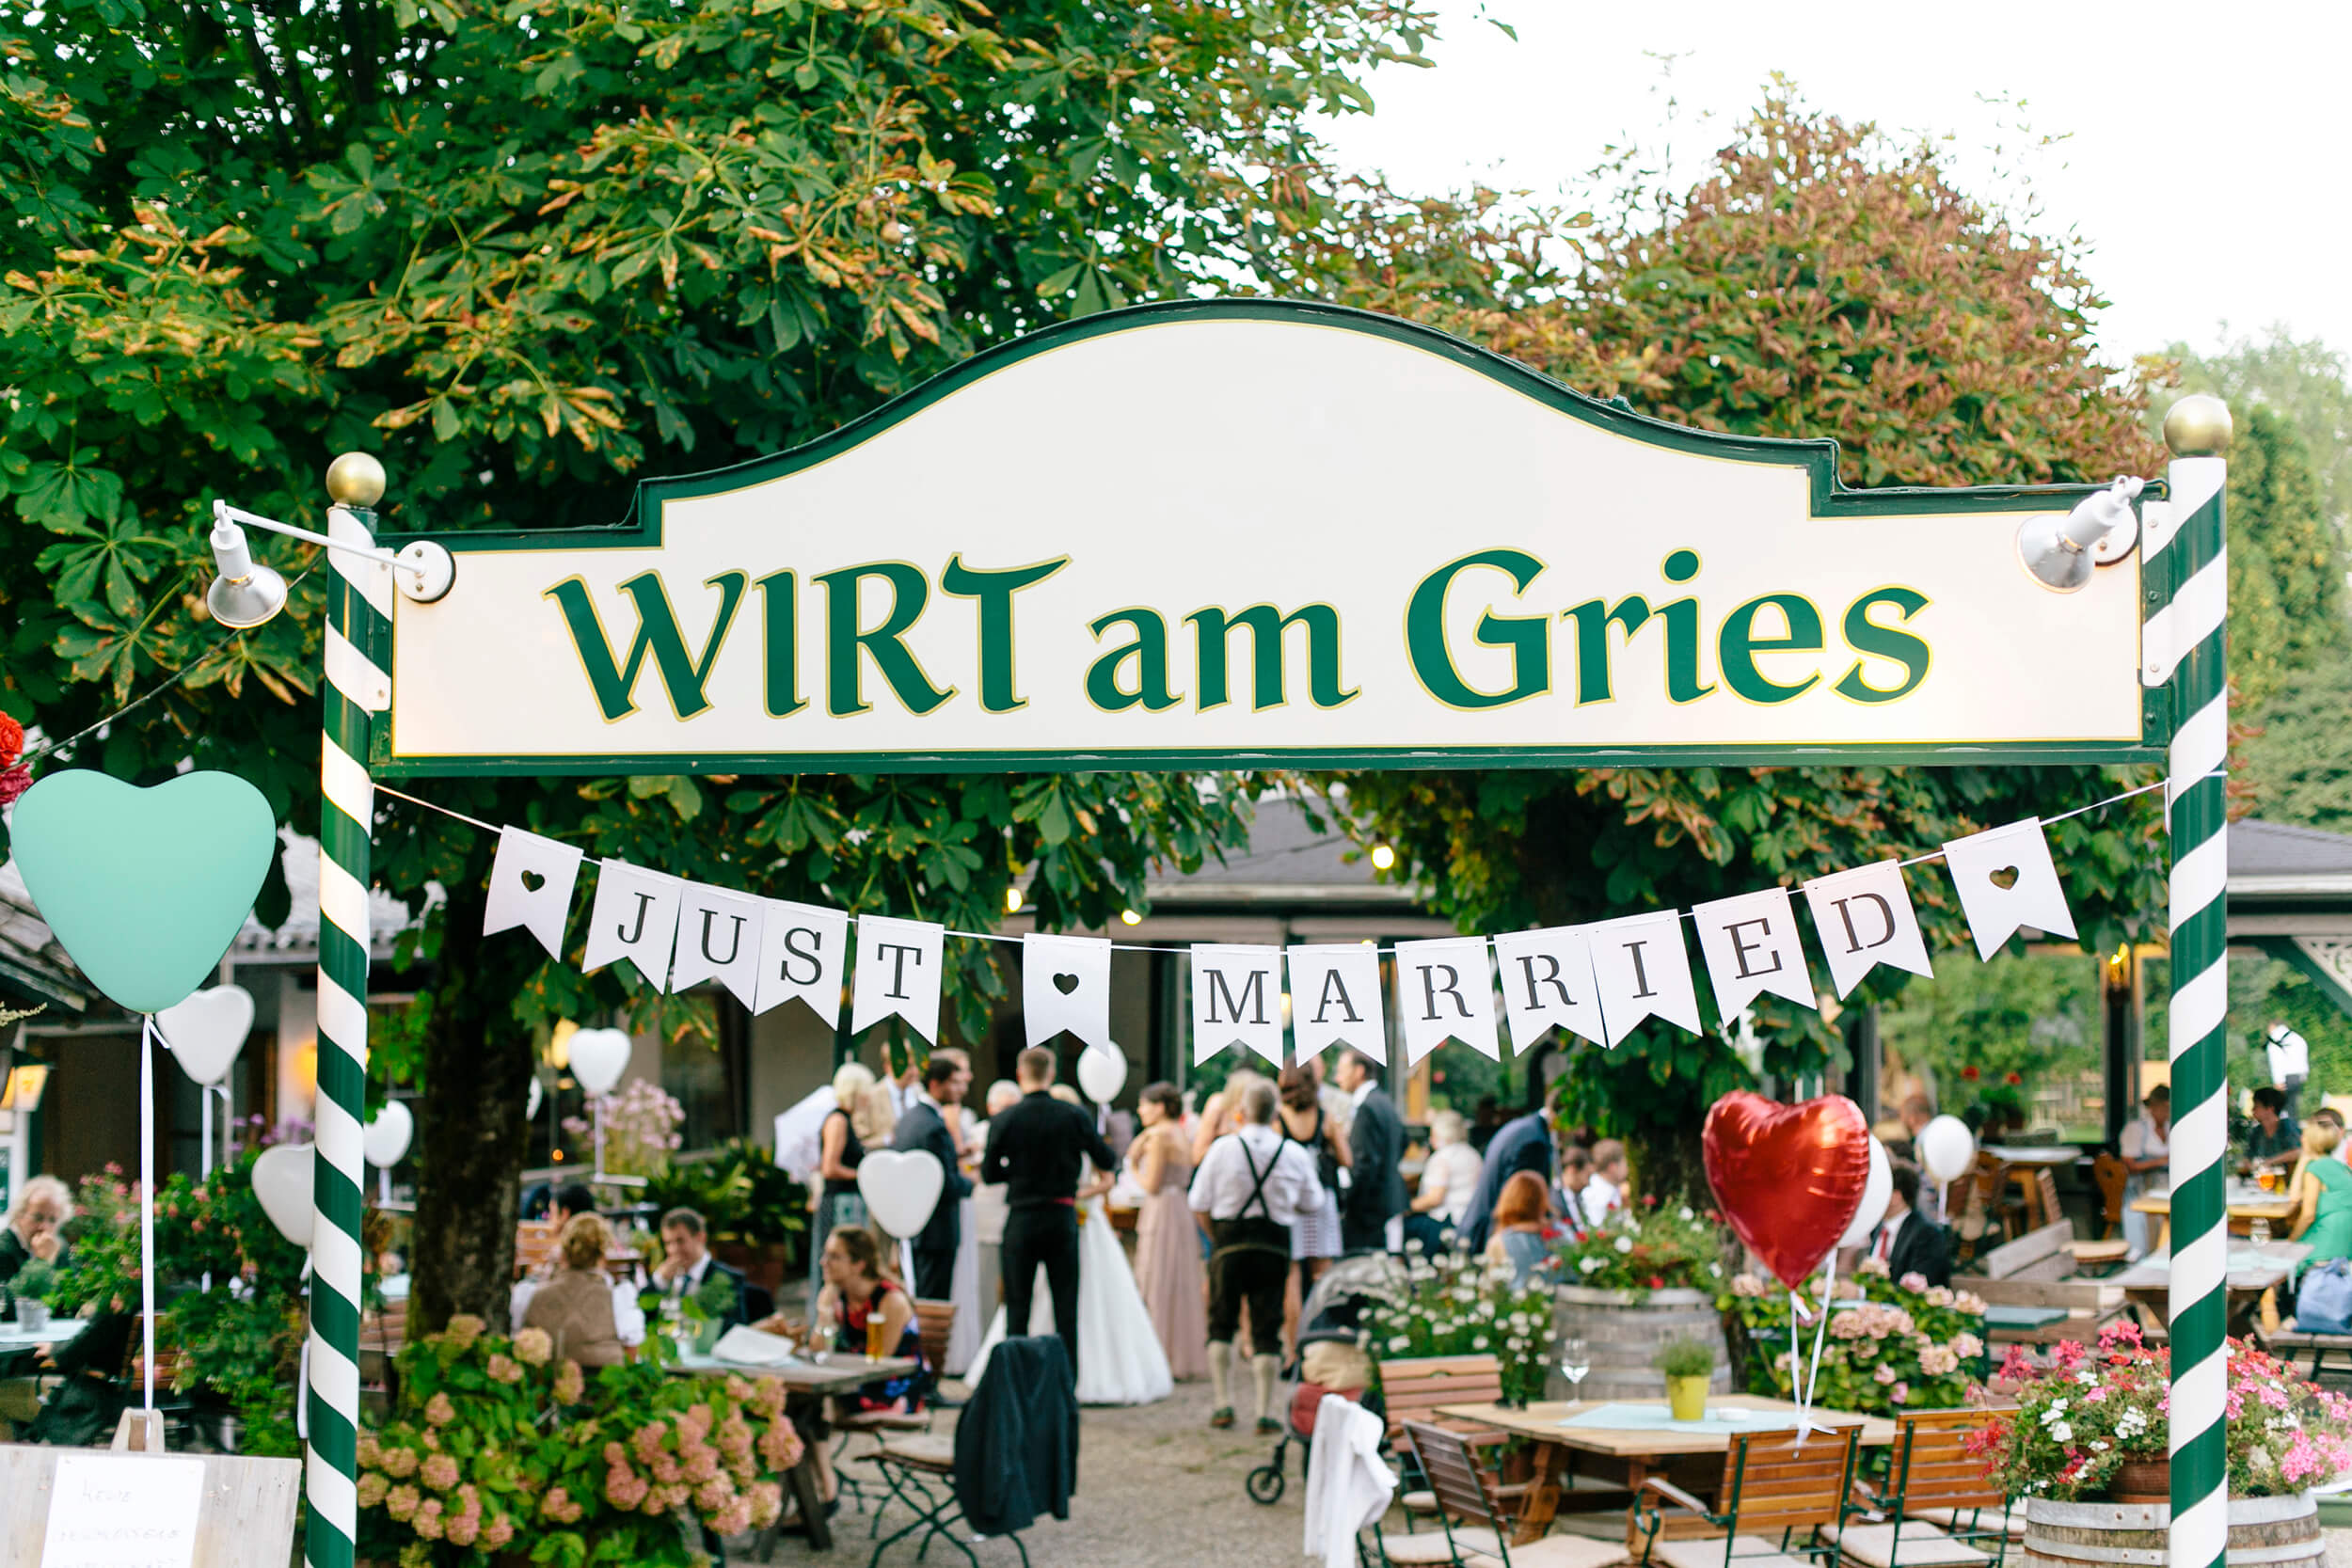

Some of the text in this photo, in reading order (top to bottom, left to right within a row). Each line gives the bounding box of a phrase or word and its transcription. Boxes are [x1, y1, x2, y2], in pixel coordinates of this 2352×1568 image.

[541, 546, 1936, 724] WIRT am Gries
[616, 892, 1896, 1024] JUST MARRIED
